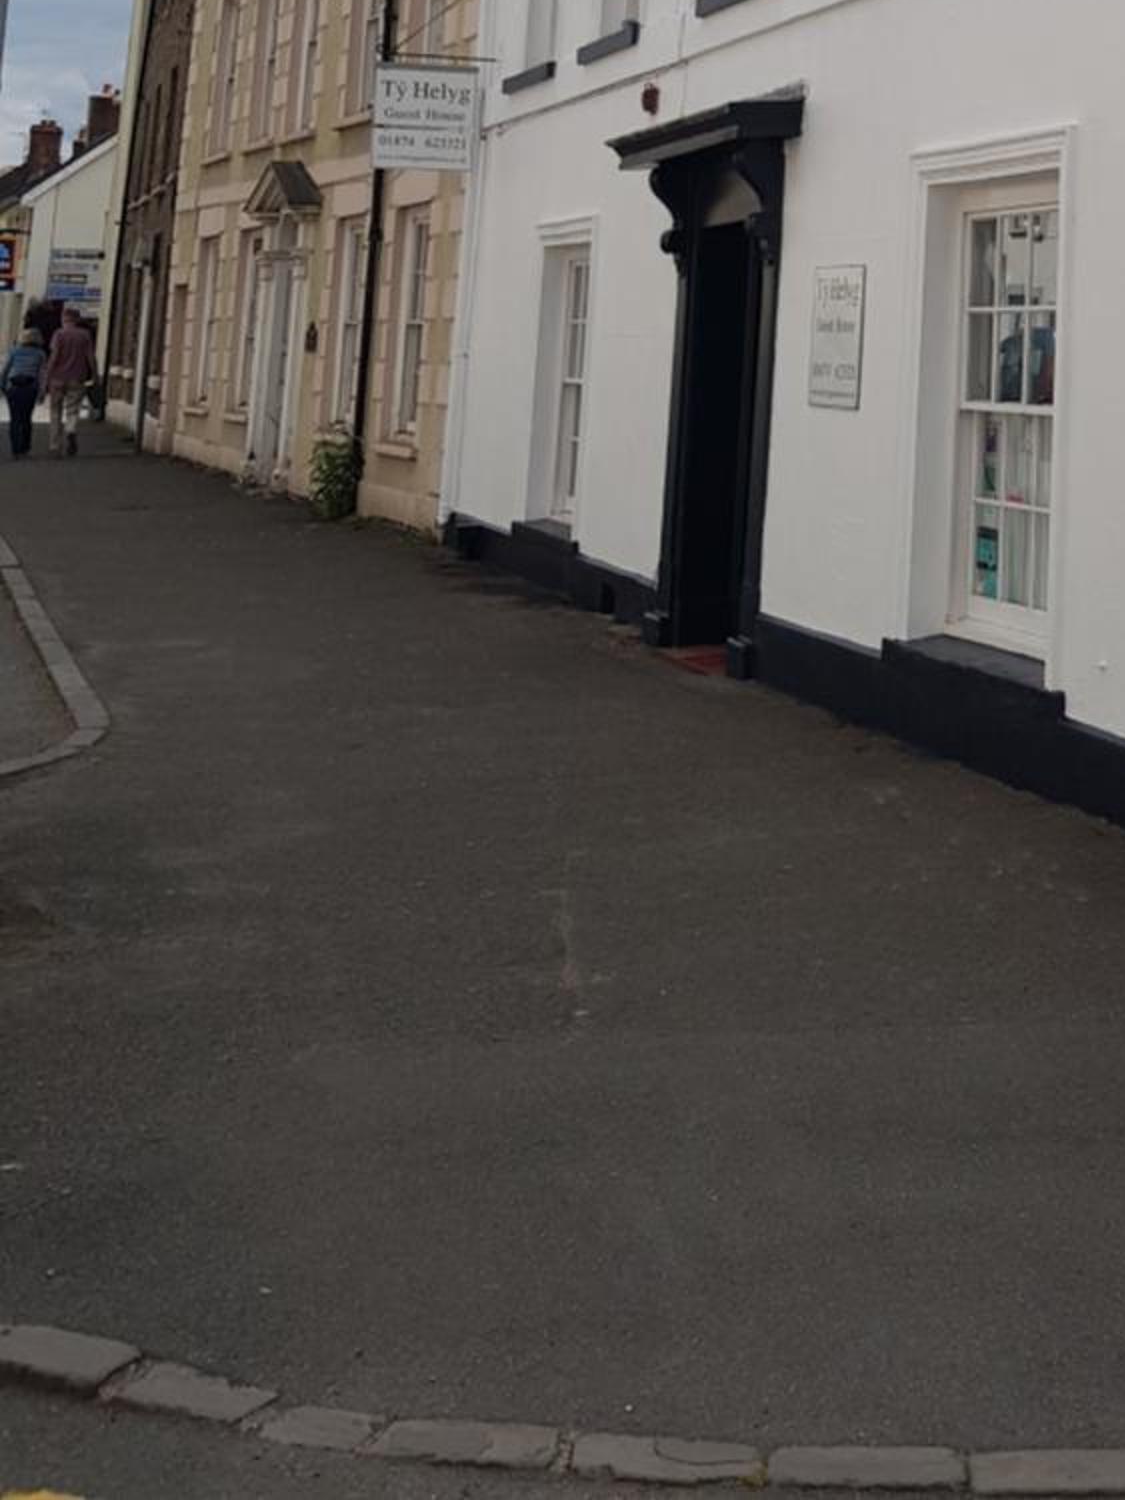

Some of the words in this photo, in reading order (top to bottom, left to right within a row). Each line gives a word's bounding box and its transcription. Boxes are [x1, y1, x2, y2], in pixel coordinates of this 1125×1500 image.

[414, 81, 471, 106] Helyg
[383, 107, 421, 119] Guest
[425, 107, 466, 121] House
